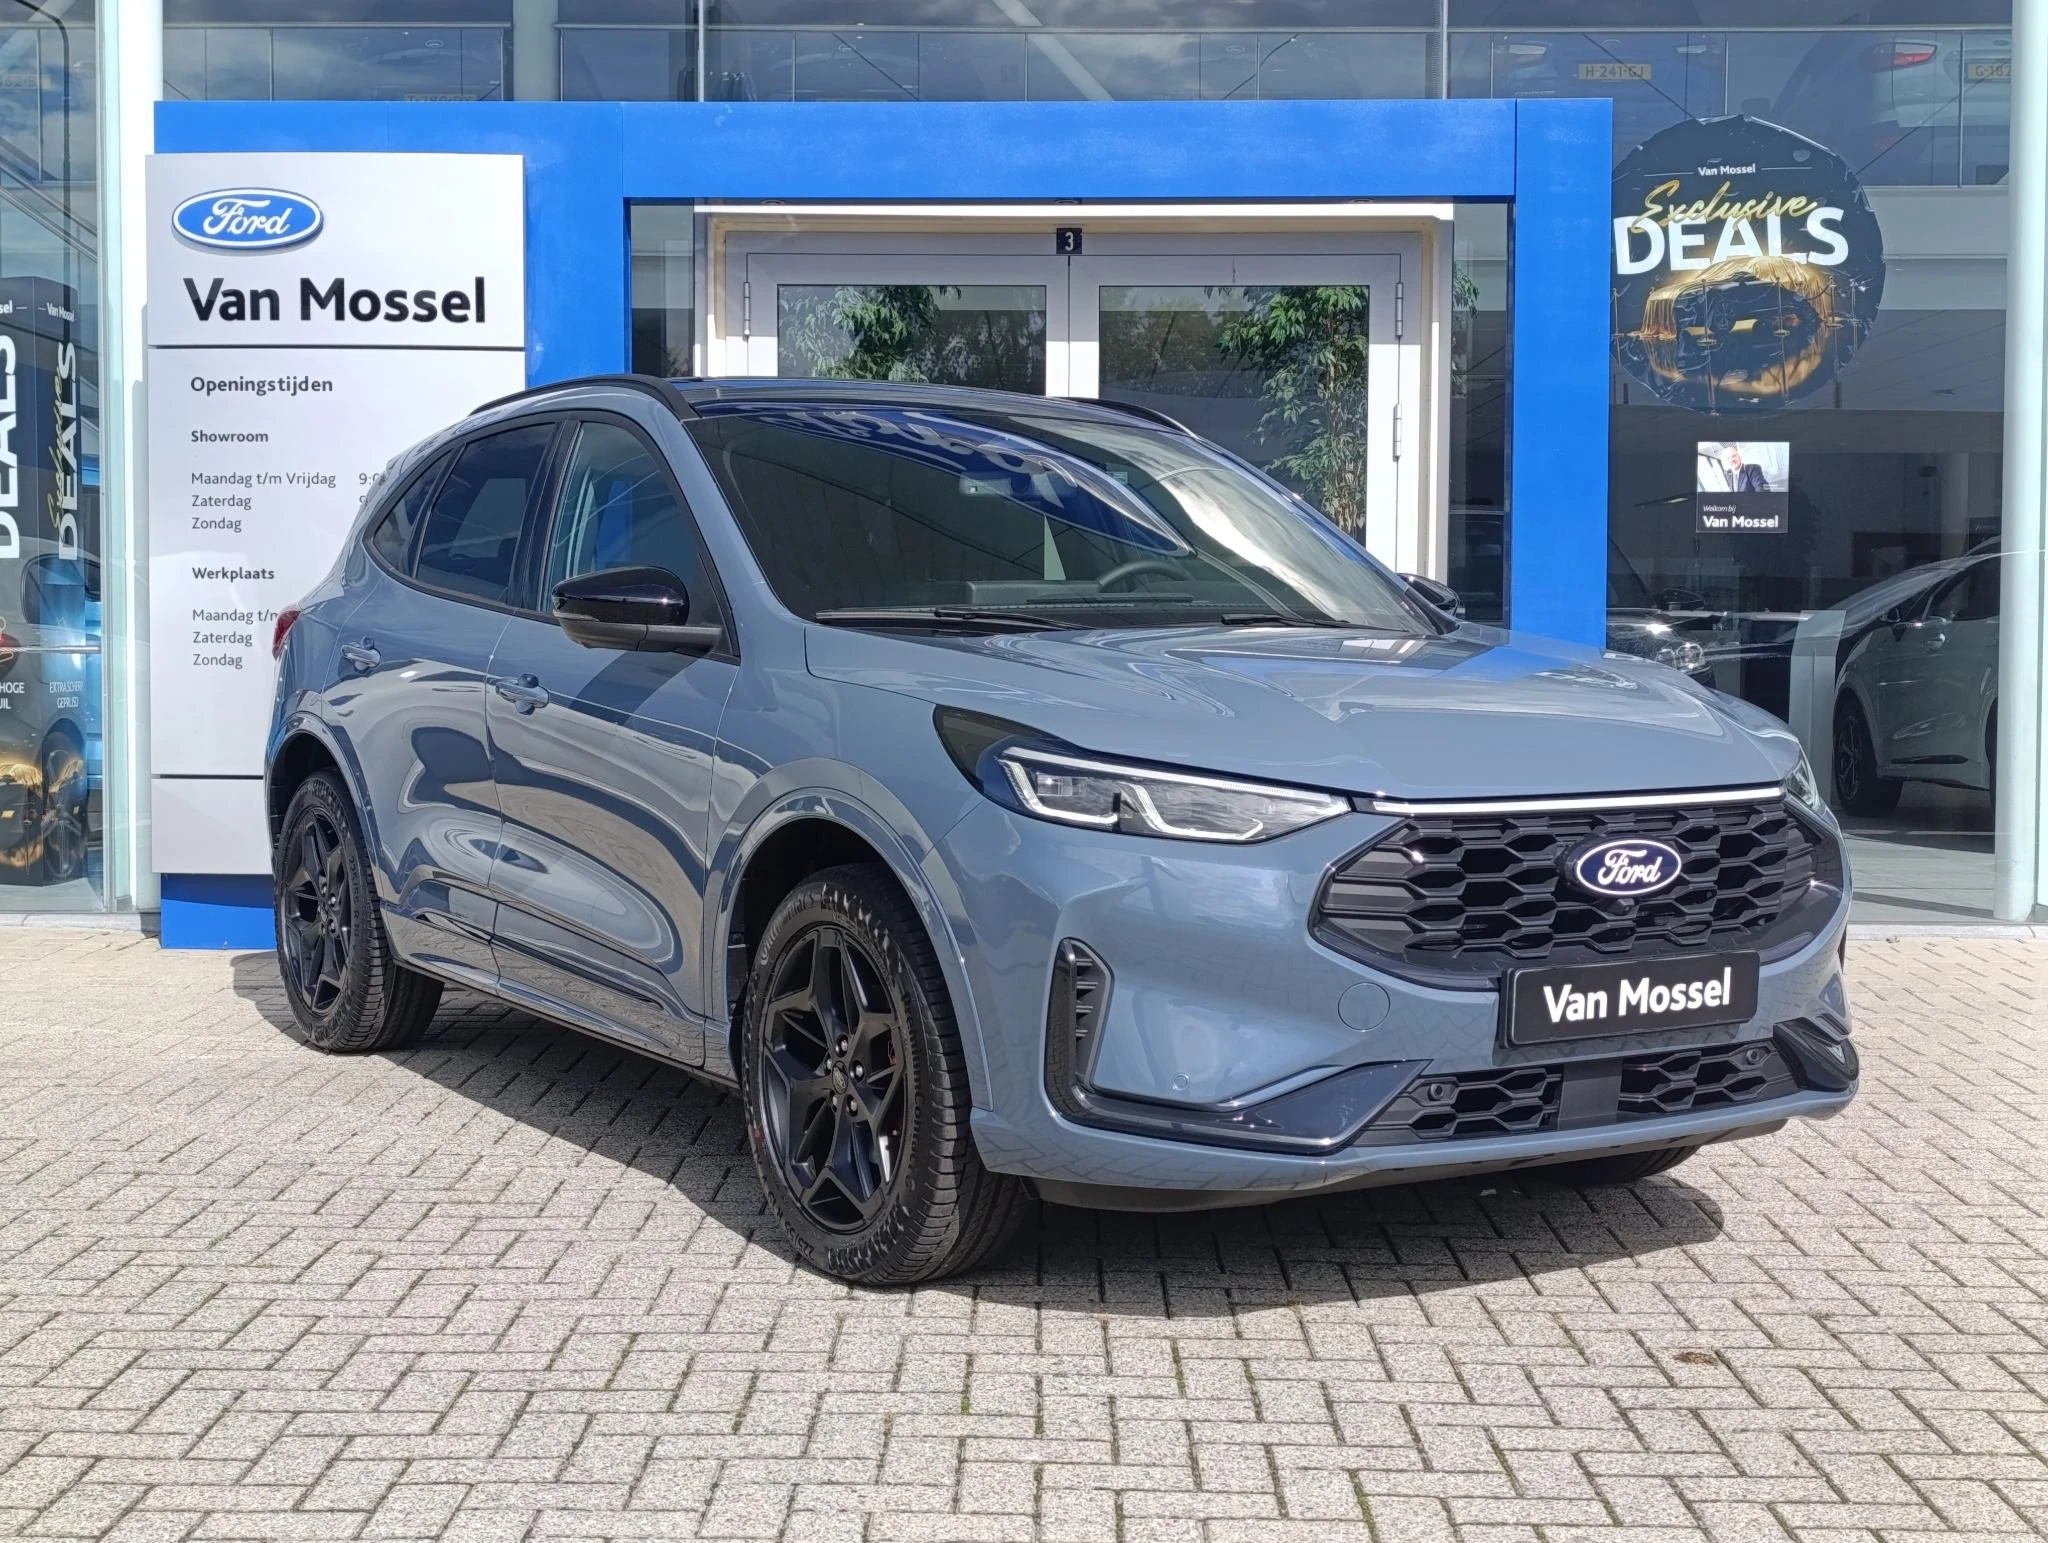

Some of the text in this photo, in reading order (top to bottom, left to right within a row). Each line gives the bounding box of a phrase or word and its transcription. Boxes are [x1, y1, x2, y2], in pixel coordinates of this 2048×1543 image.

[1697, 163, 1756, 177] Van Mossel
[1631, 179, 1818, 234] Exclusive
[203, 197, 293, 236] Ford
[1065, 231, 1074, 251] 3
[1613, 206, 1849, 275] DEALS
[182, 276, 486, 324] Van Mossel
[46, 301, 59, 318] Van
[190, 376, 333, 396] Openingstijden
[191, 429, 269, 443] Showroom
[57, 342, 78, 560] DEALS
[191, 472, 253, 488] Maandag
[256, 472, 282, 486] t/m
[285, 472, 337, 488] Vrijdag
[191, 494, 252, 510] Zaterdag
[1703, 504, 1737, 513] Welkom bij
[191, 517, 242, 533] Zondag
[1702, 514, 1779, 528] Van Mossel
[192, 566, 275, 583] Werkplaats
[192, 608, 254, 625] Maandag
[192, 631, 253, 647] Zaterdag
[192, 653, 243, 670] Zondag
[1597, 848, 1663, 886] Ford
[1543, 966, 1732, 1023] Van Mossel
